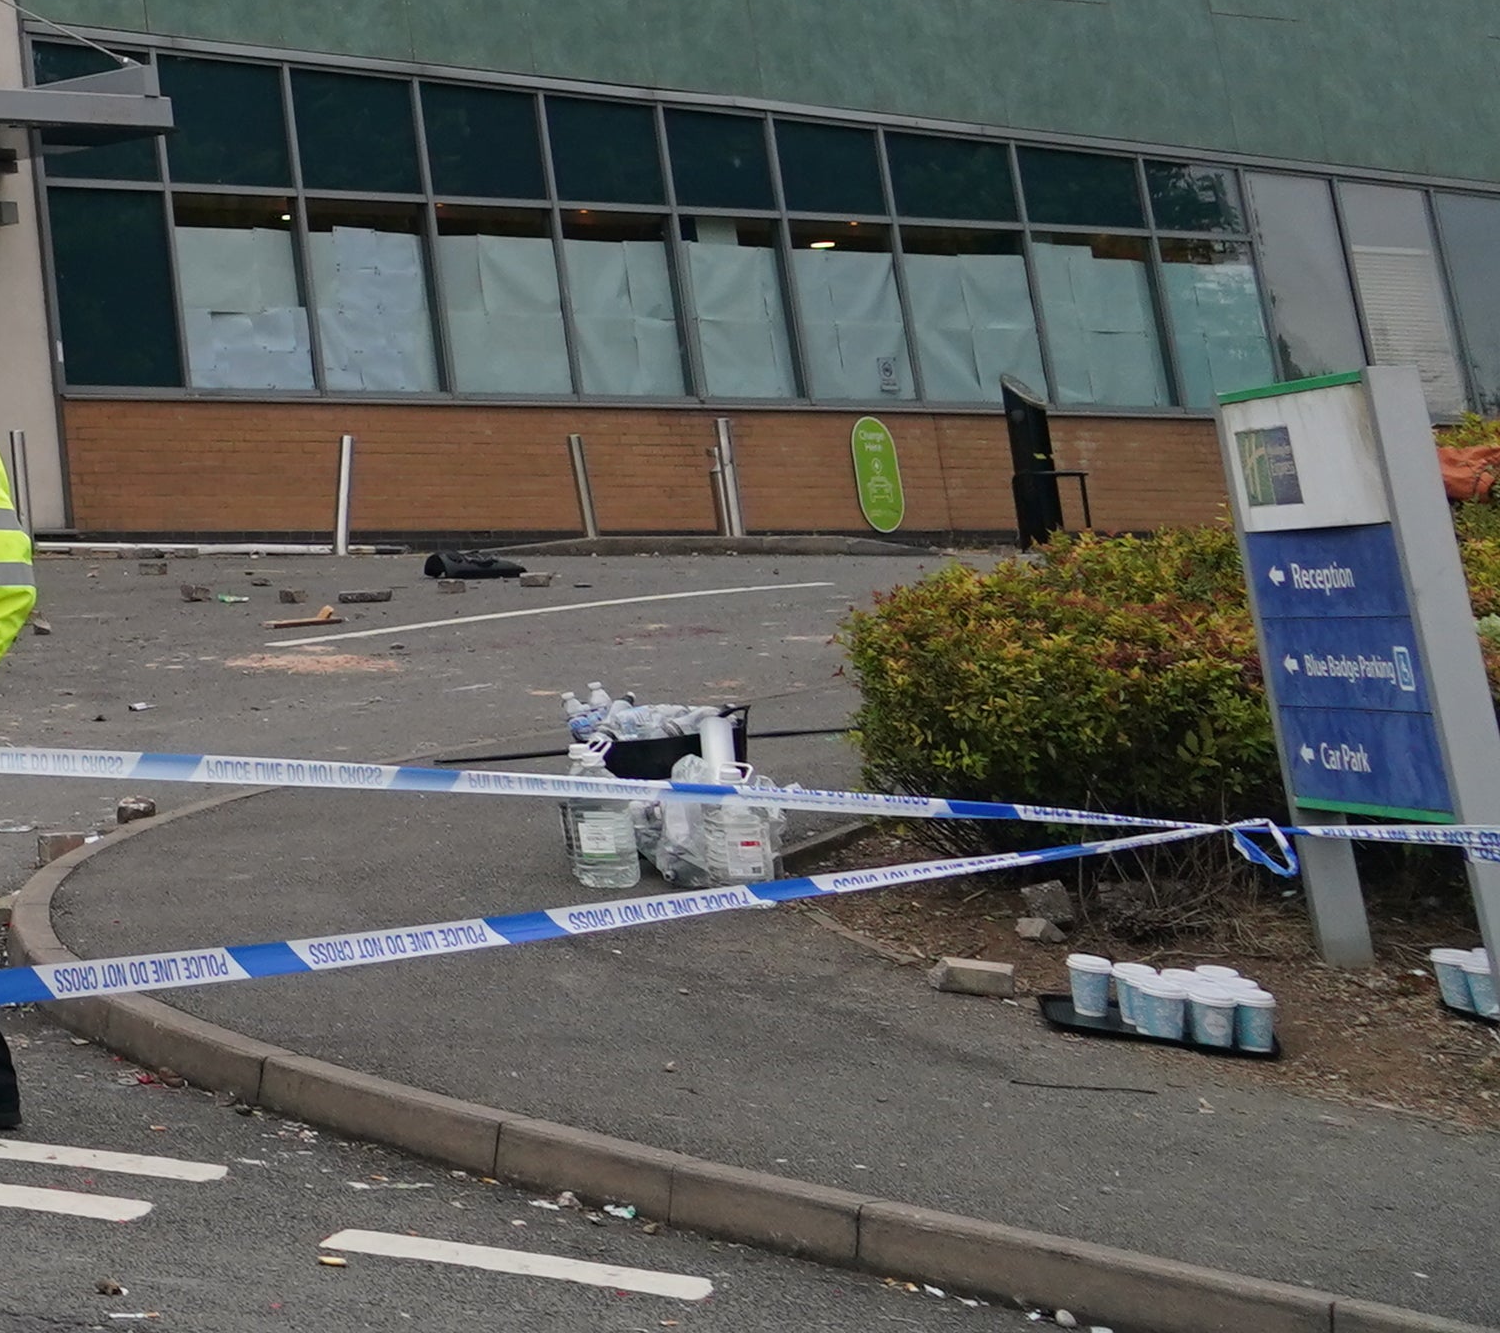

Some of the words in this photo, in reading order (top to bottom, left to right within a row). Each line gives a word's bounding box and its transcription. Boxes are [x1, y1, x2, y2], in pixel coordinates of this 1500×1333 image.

[859, 430, 885, 442] Charge
[1290, 561, 1355, 596] Reception
[1303, 654, 1326, 677] Blue
[1327, 655, 1360, 683] Badge
[1358, 655, 1397, 685] Parking
[1320, 742, 1340, 770] Car
[1343, 744, 1372, 773] Park
[617, 904, 645, 923] NOT
[647, 902, 667, 919] DO
[668, 897, 701, 917] LINE
[569, 908, 615, 930] CROSS
[386, 934, 406, 955] DO
[410, 931, 439, 952] LINE
[441, 925, 487, 948] POLICE
[309, 940, 354, 964] CROSS
[360, 937, 385, 960] NOT
[102, 964, 129, 988] NOT
[130, 963, 148, 984] DO
[151, 957, 183, 981] LINE
[185, 953, 229, 979] POLICE
[54, 966, 98, 993] CROSS
